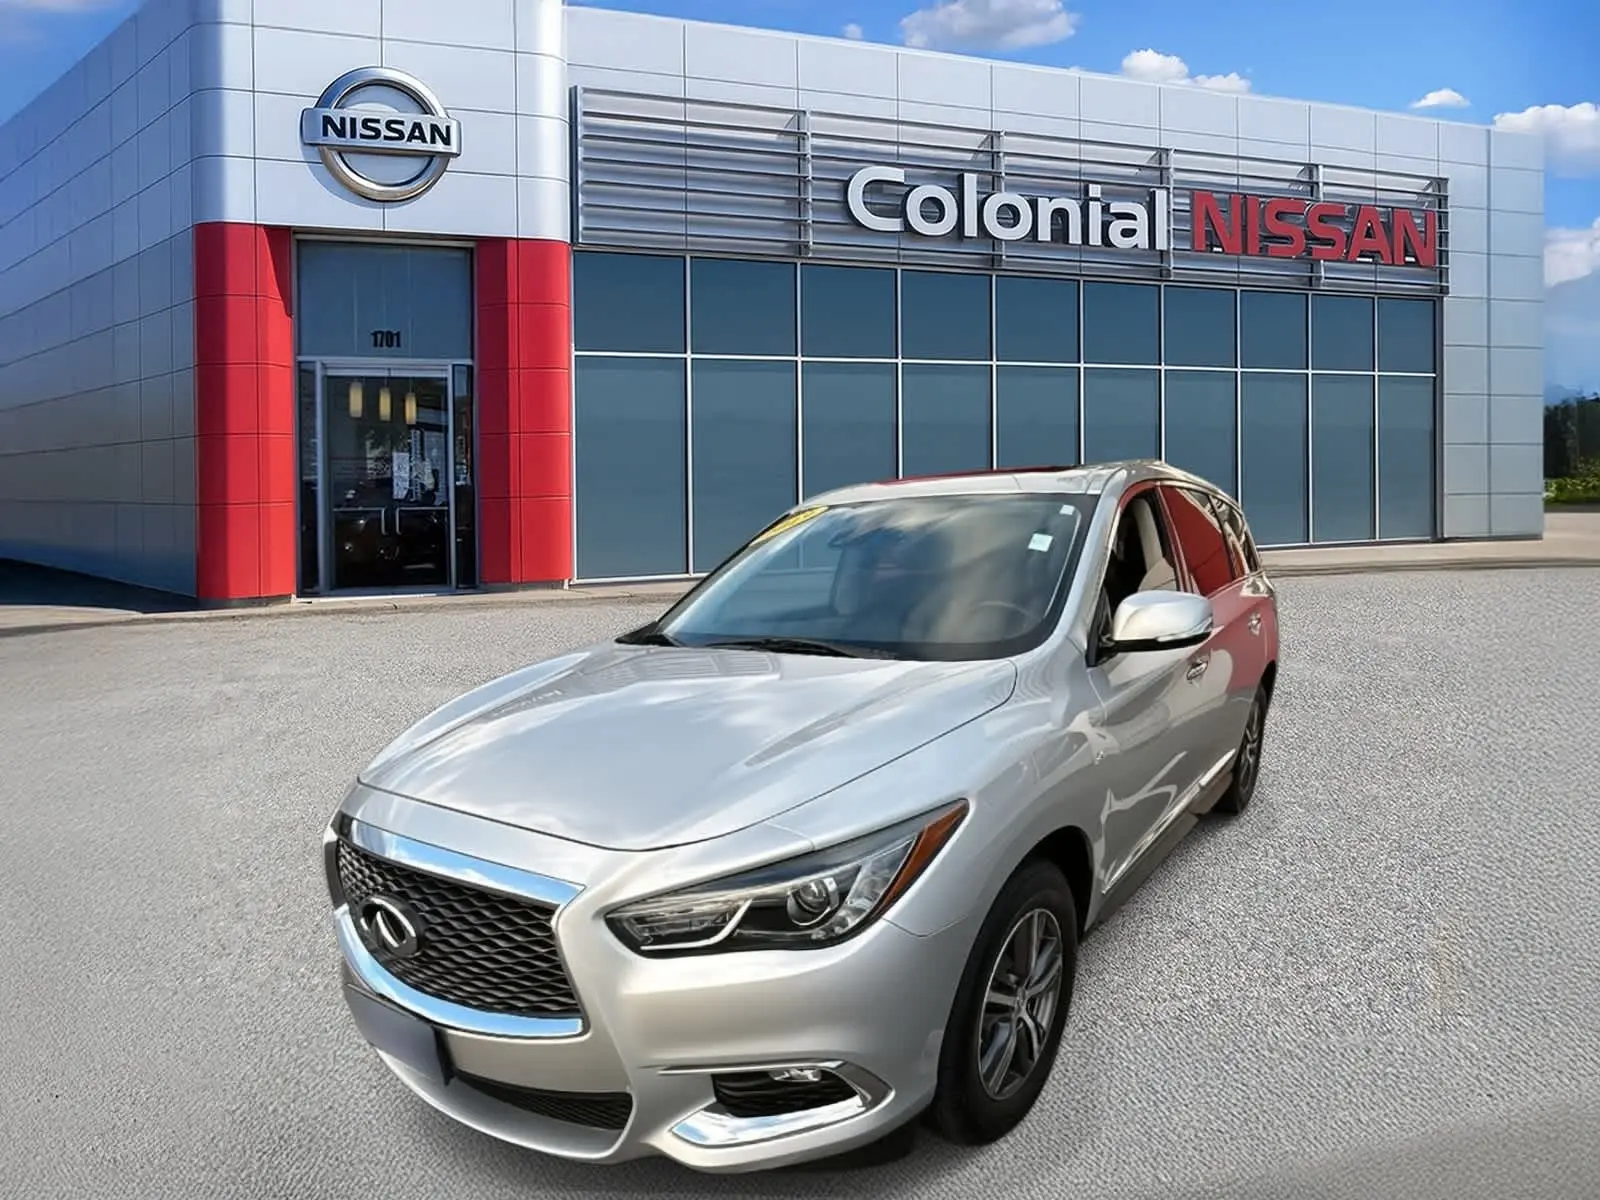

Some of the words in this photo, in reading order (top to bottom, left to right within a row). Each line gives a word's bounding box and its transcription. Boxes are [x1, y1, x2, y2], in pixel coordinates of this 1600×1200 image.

[321, 115, 451, 146] NISSAN
[847, 165, 1169, 250] Colonial
[1191, 190, 1437, 268] NISSAN
[370, 330, 401, 348] 1701
